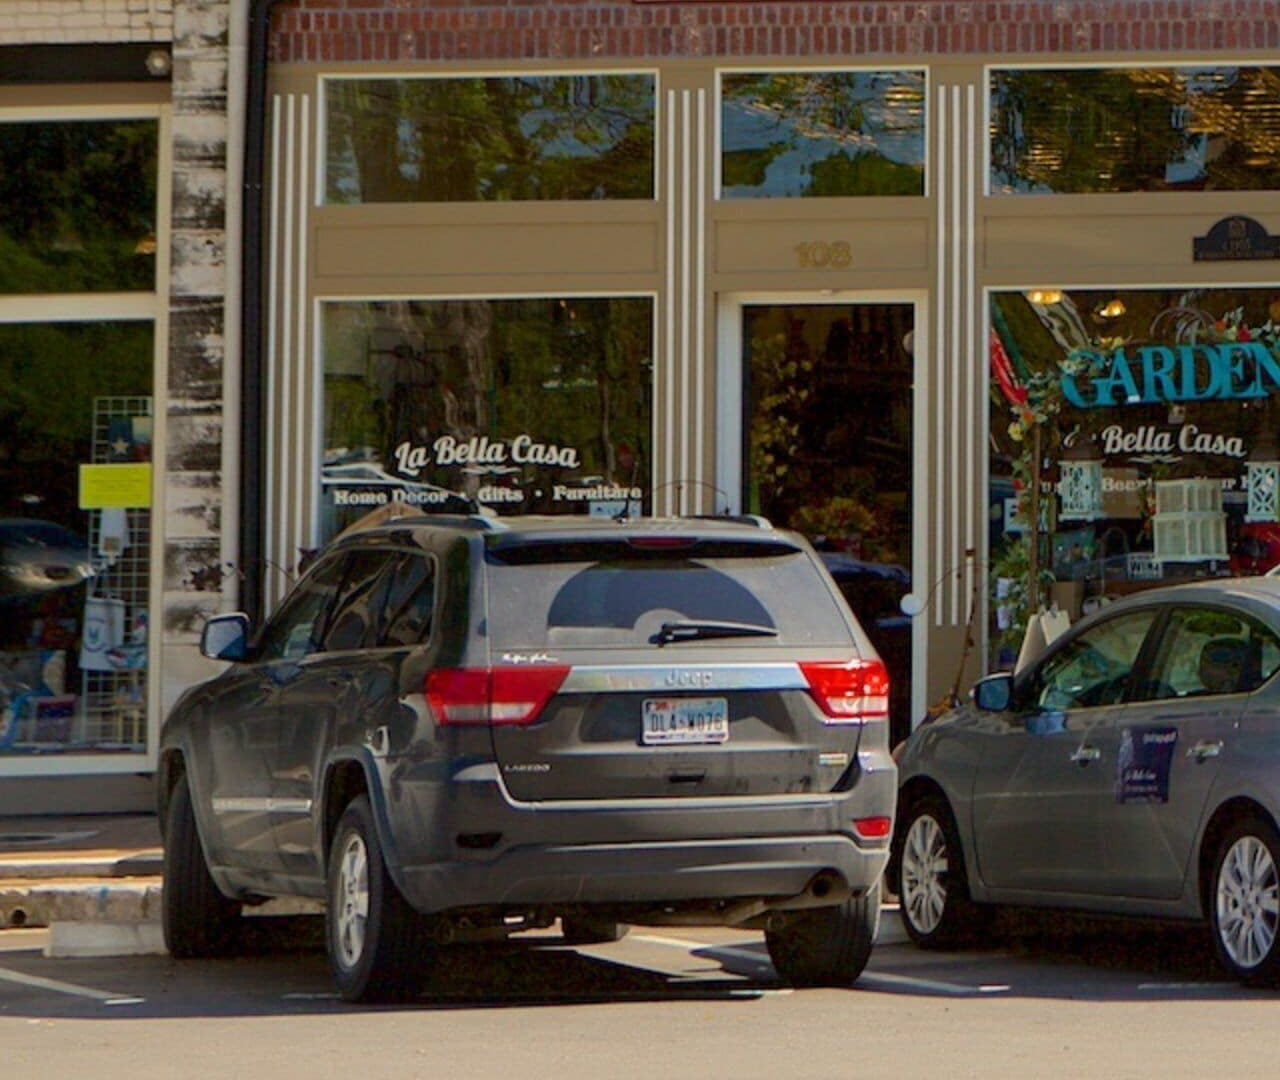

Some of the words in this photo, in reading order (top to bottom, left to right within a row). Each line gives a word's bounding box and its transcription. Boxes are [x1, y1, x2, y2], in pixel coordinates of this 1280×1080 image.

[794, 241, 851, 268] 108
[1102, 423, 1176, 455] Bella
[1178, 424, 1248, 457] Casa
[394, 441, 430, 476] La
[432, 434, 507, 465] Bella
[510, 434, 582, 469] Casa
[333, 489, 388, 505] Home
[390, 488, 450, 504] Decor
[477, 485, 525, 503] Gifts
[552, 483, 643, 501] Furniture
[664, 670, 714, 687] Jeep
